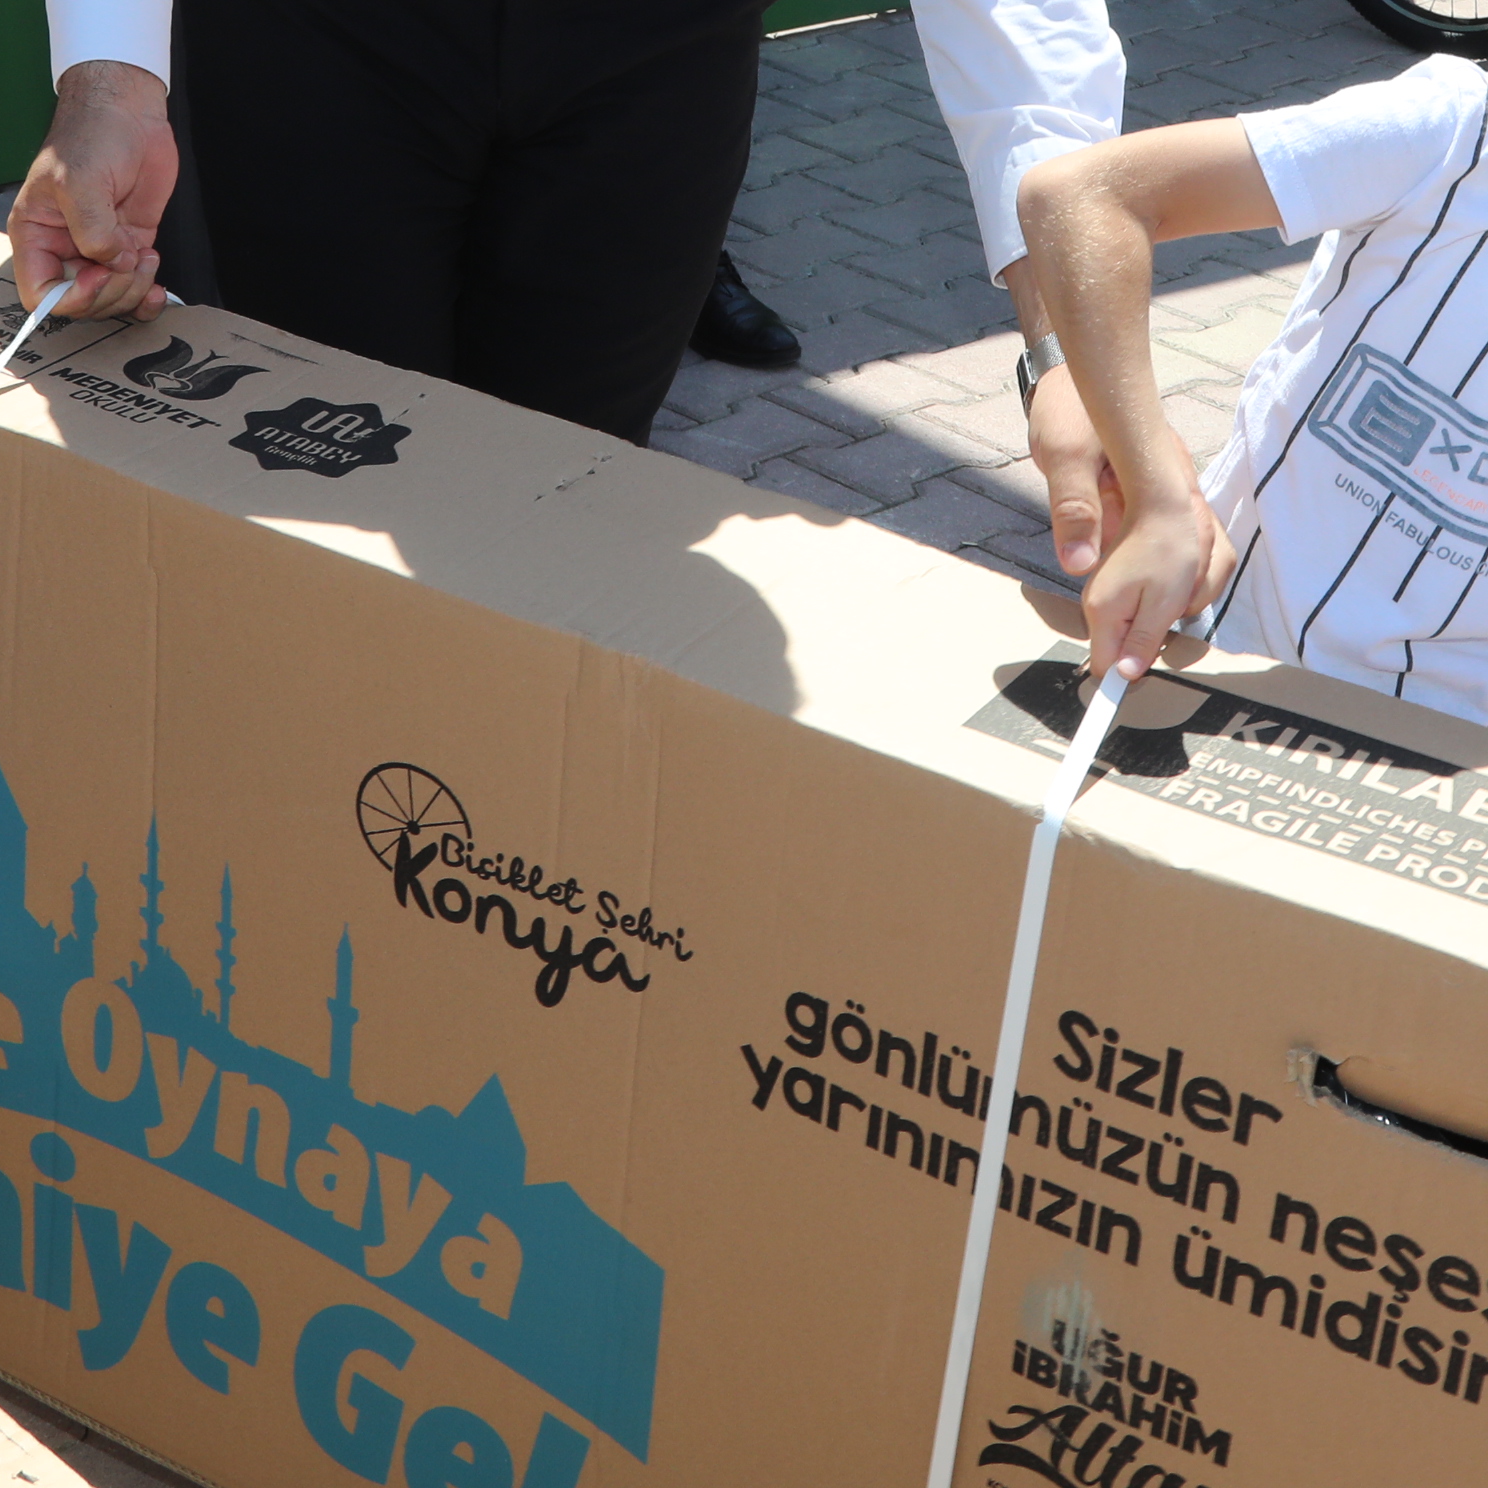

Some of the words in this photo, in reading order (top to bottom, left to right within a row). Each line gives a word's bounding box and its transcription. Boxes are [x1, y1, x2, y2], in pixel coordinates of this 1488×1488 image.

[69, 389, 160, 424] OKULU
[253, 426, 363, 464] ATABEY
[1334, 473, 1387, 518] UNION
[1384, 511, 1474, 571] FABULOUS
[1158, 776, 1358, 856] FRAGILE
[1186, 750, 1457, 847] EMPFINDLICHES
[394, 829, 652, 1009] Konya
[440, 832, 587, 915] Bisiklet
[783, 990, 1241, 1224] gönlümüzün
[1051, 1009, 1285, 1148] Sizler
[61, 976, 524, 1322] Oynaya
[738, 1042, 1144, 1266] yarınımızın
